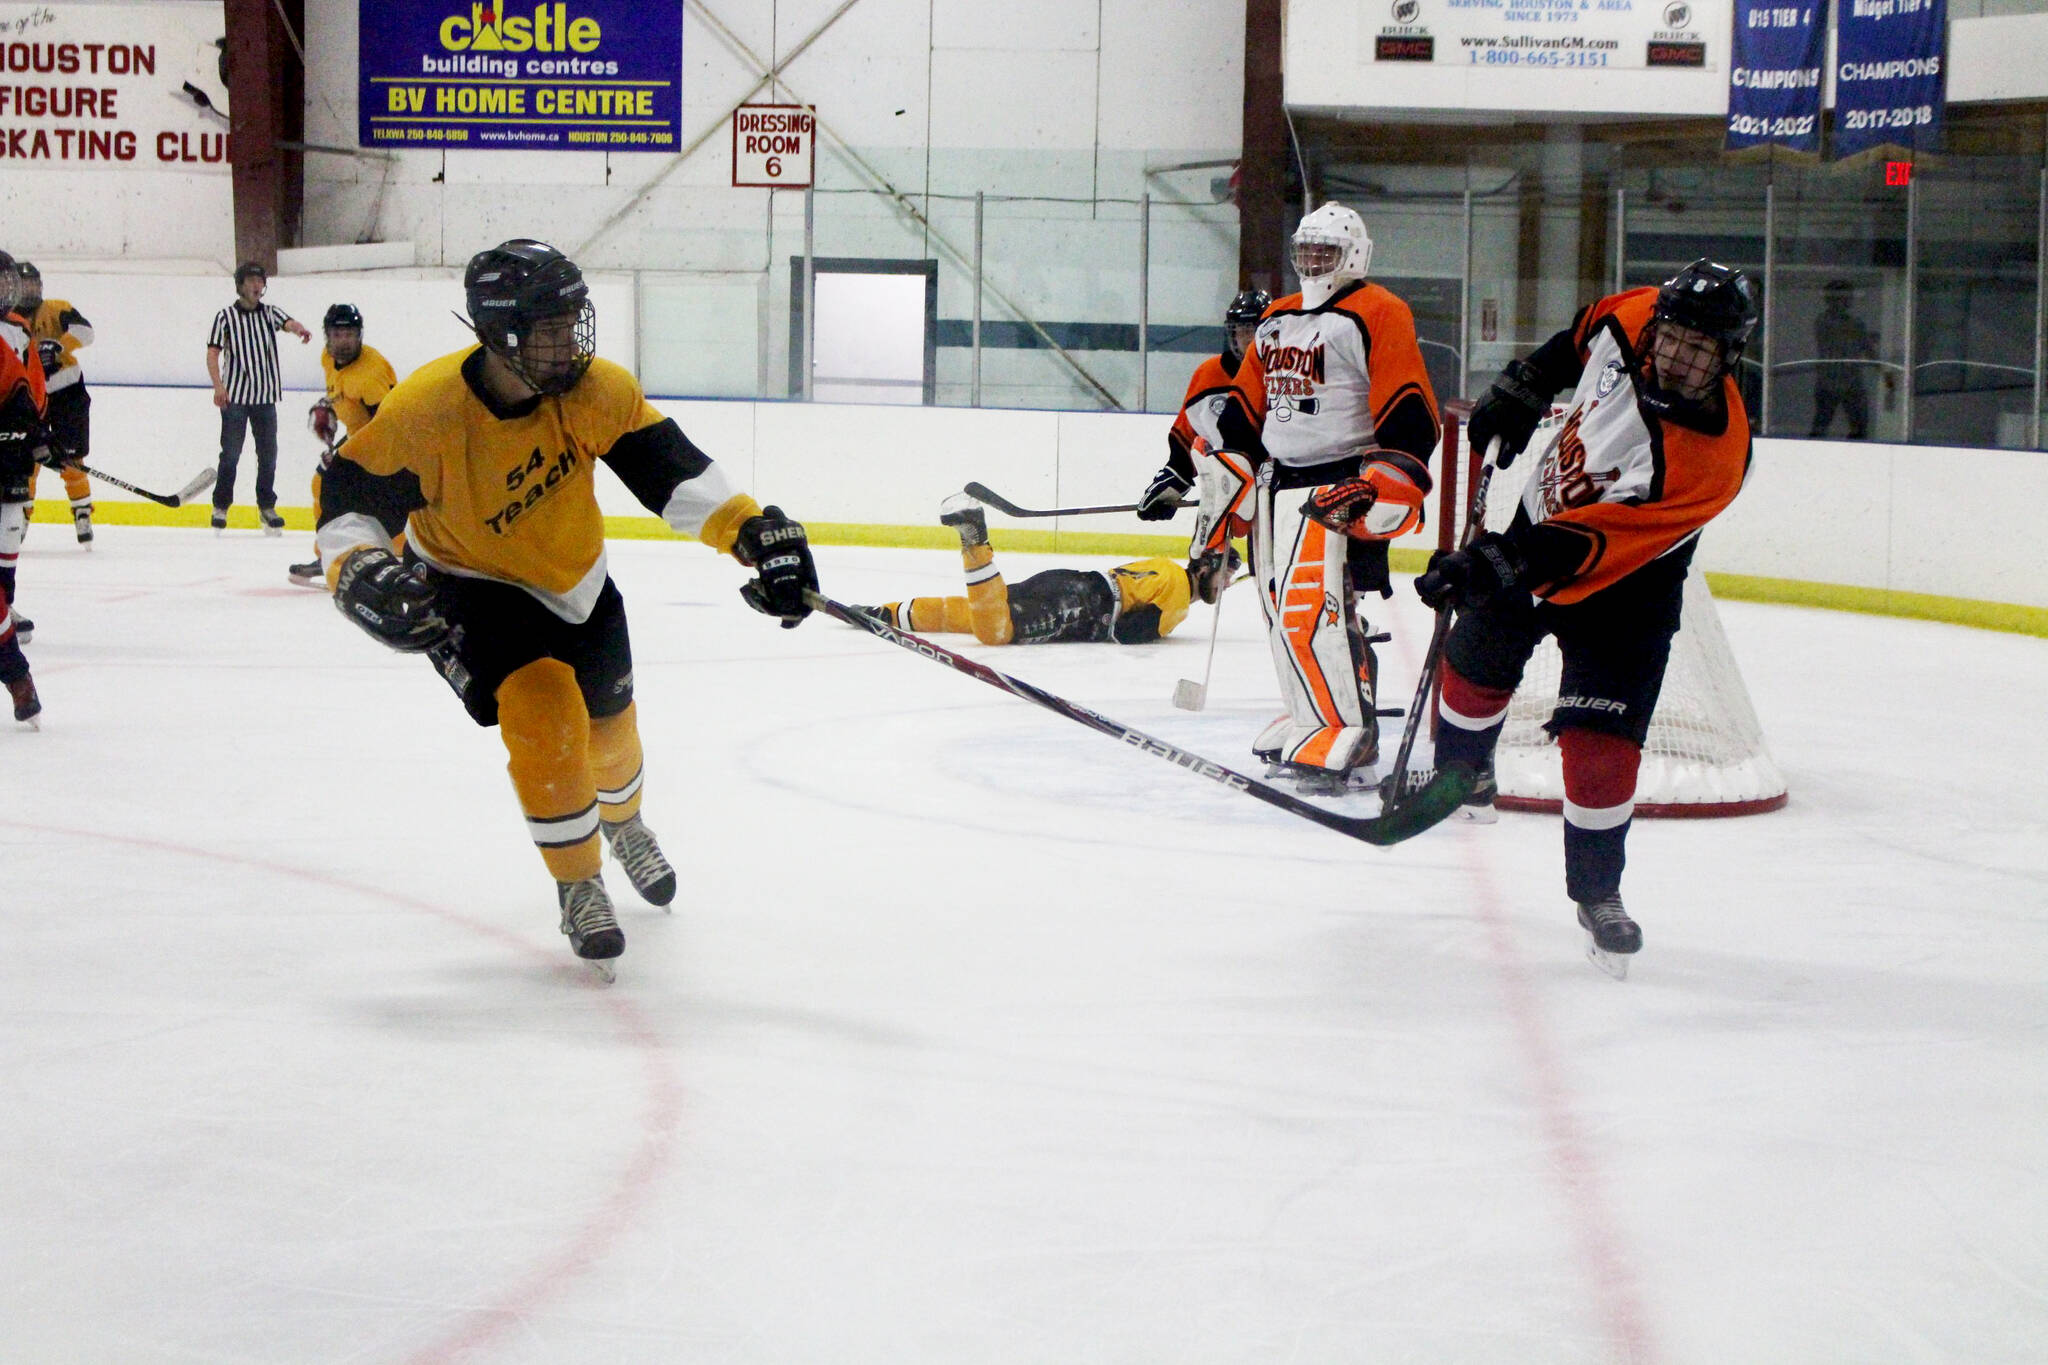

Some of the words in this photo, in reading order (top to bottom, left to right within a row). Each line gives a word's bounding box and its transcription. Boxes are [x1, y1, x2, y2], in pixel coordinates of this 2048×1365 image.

[1597, 0, 1632, 11] AREA
[1503, 11, 1541, 22] SINCE
[1546, 12, 1579, 22] 1973
[1748, 9, 1770, 28] U15
[1772, 8, 1798, 27] TIER
[1461, 36, 1619, 50] www.SullivanGM.com
[422, 55, 518, 78] building
[526, 56, 619, 75] centres
[1470, 50, 1608, 67] 1-800-665-3151
[1840, 56, 1940, 80] CHAMPIONS
[0, 85, 118, 119] FIGURE
[388, 87, 426, 112] BV
[436, 88, 526, 114] HOME
[536, 89, 654, 116] CENTRE
[739, 113, 811, 133] DRESSING
[1845, 105, 1933, 129] 2017-2018
[373, 128, 405, 140] TELKWA
[480, 130, 559, 142] www.bvhome.ca
[568, 132, 608, 143] HOUSTON
[745, 135, 801, 155] ROOM
[156, 131, 232, 163] CLU
[765, 157, 782, 177] 6
[506, 446, 545, 491] 54
[1121, 728, 1250, 793] BAUER
